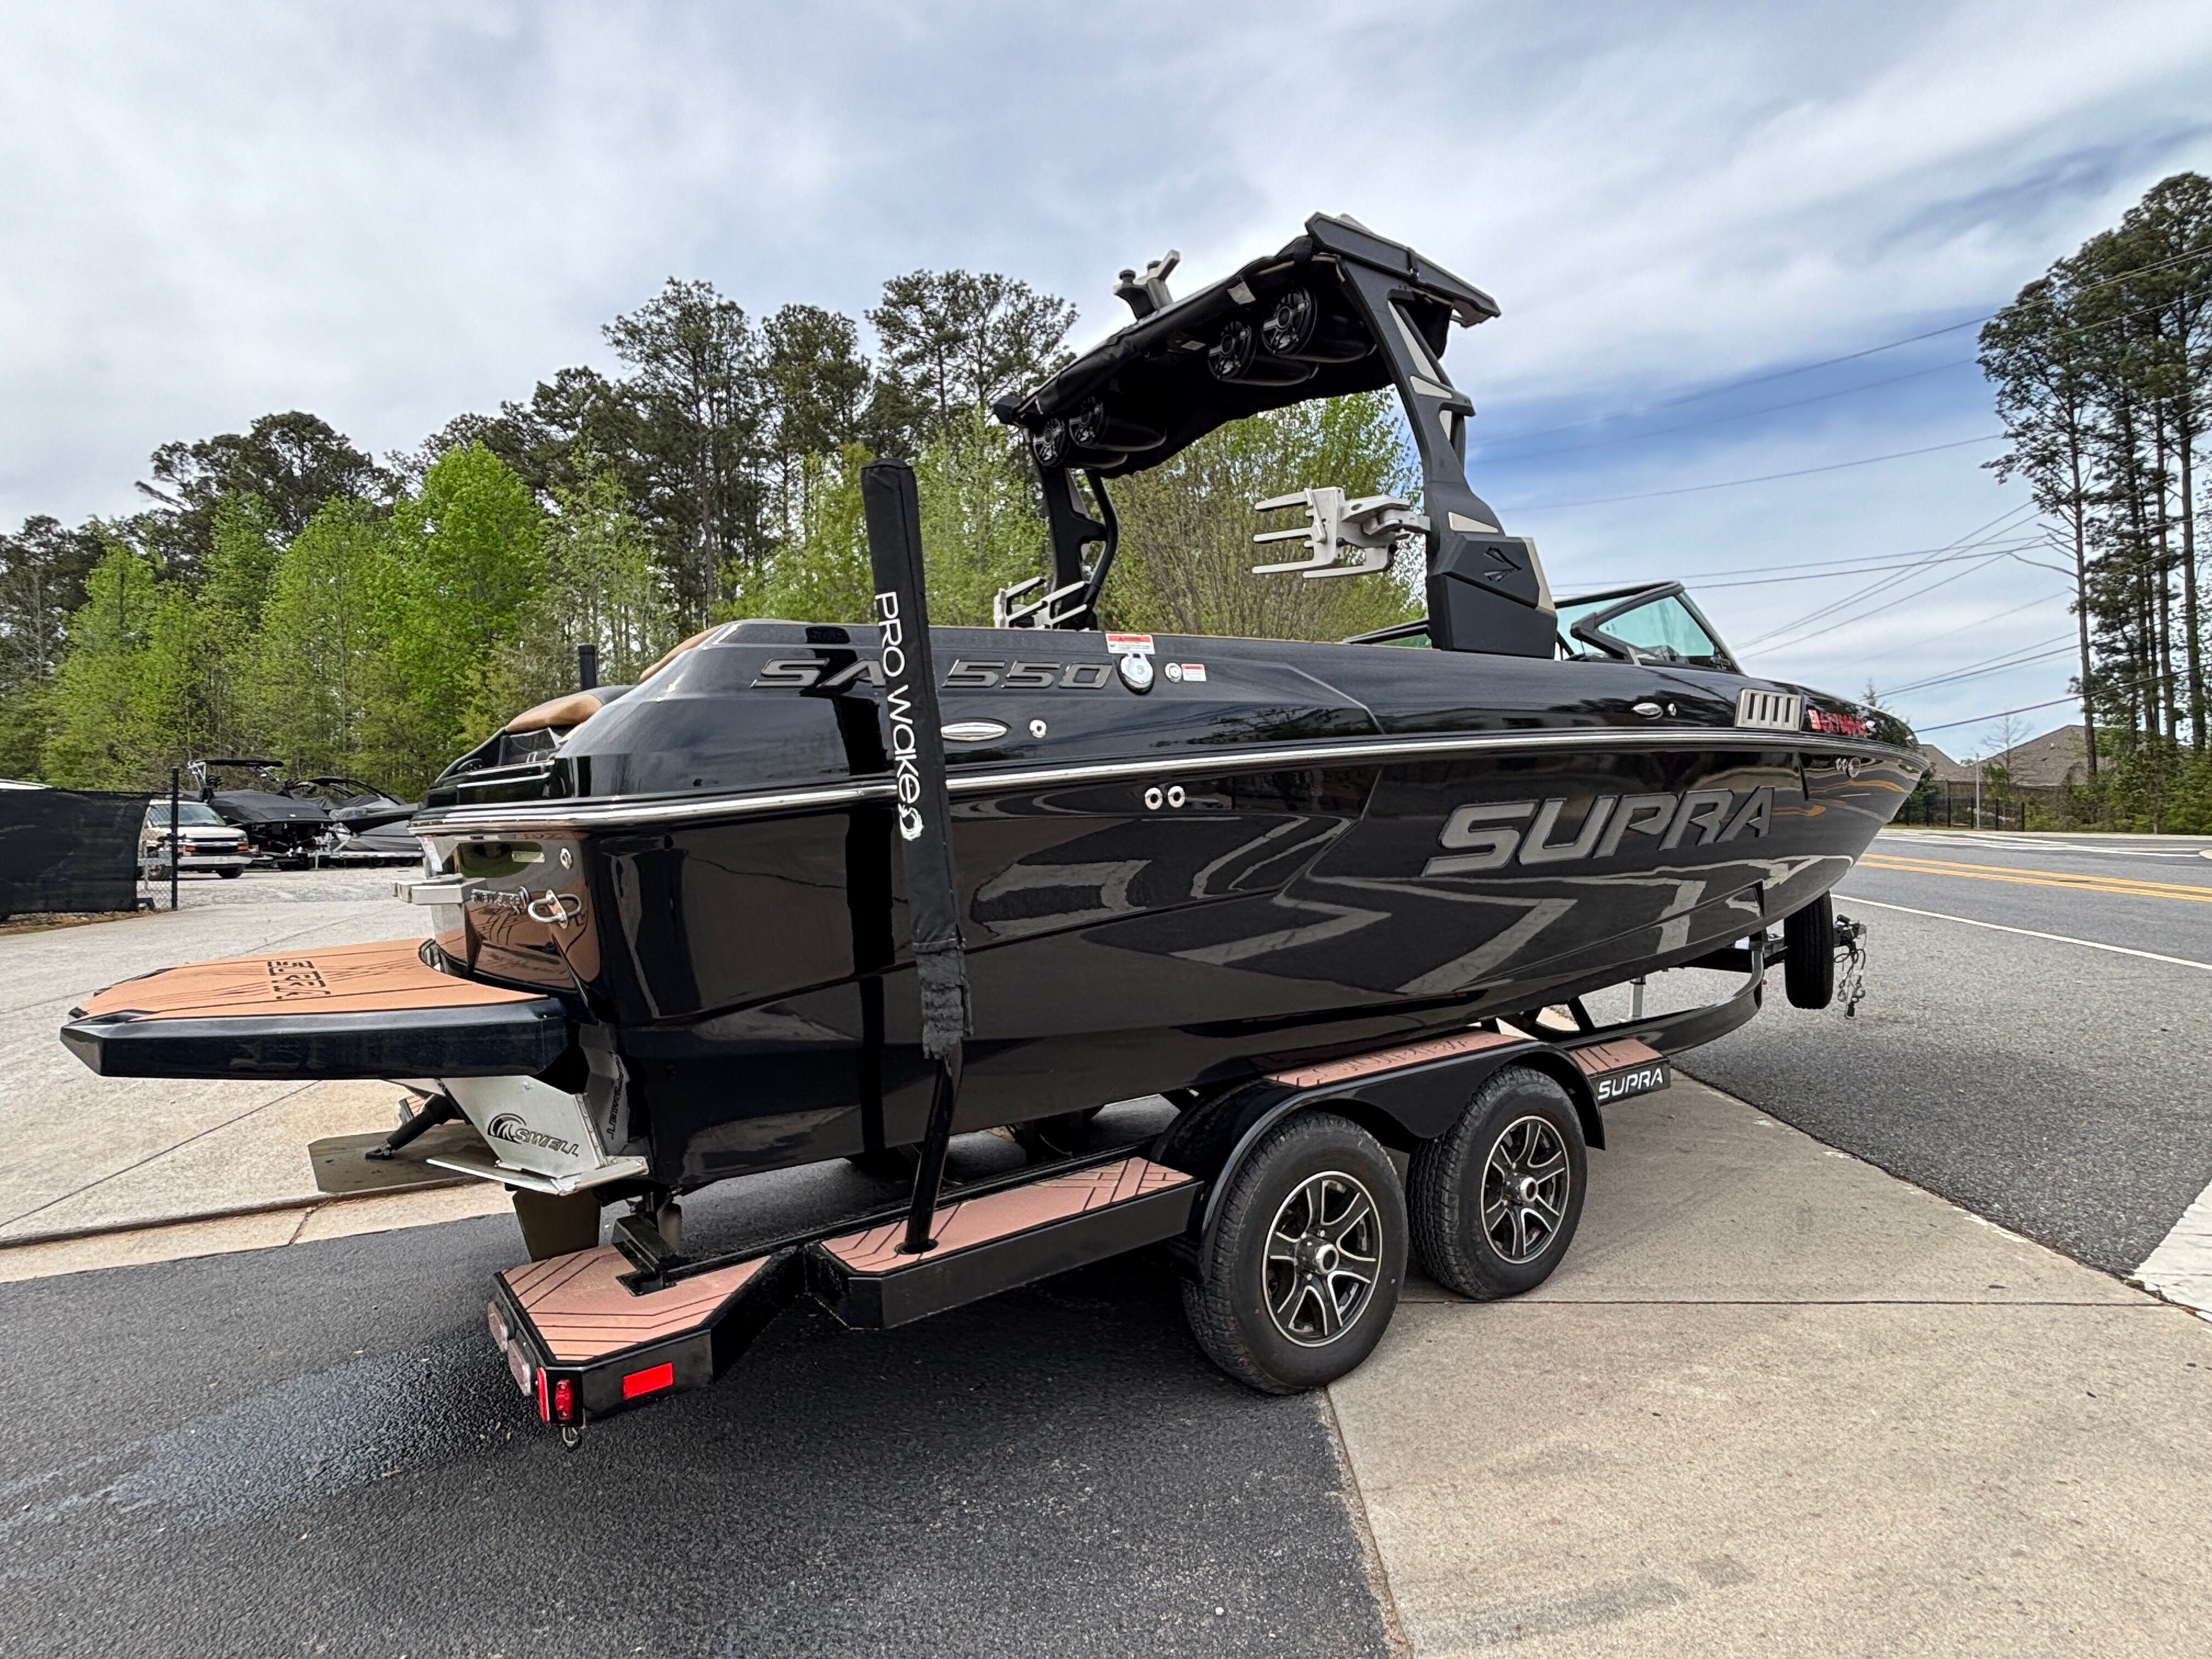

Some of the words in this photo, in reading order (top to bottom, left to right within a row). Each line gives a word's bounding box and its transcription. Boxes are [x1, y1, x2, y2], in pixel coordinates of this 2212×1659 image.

[875, 591, 905, 677] PRO
[751, 658, 886, 688] SA
[943, 658, 1114, 689] 550
[1419, 785, 1775, 878] SUPRA
[1597, 1068, 1663, 1101] SUPRA
[514, 1127, 580, 1157] SWELL
